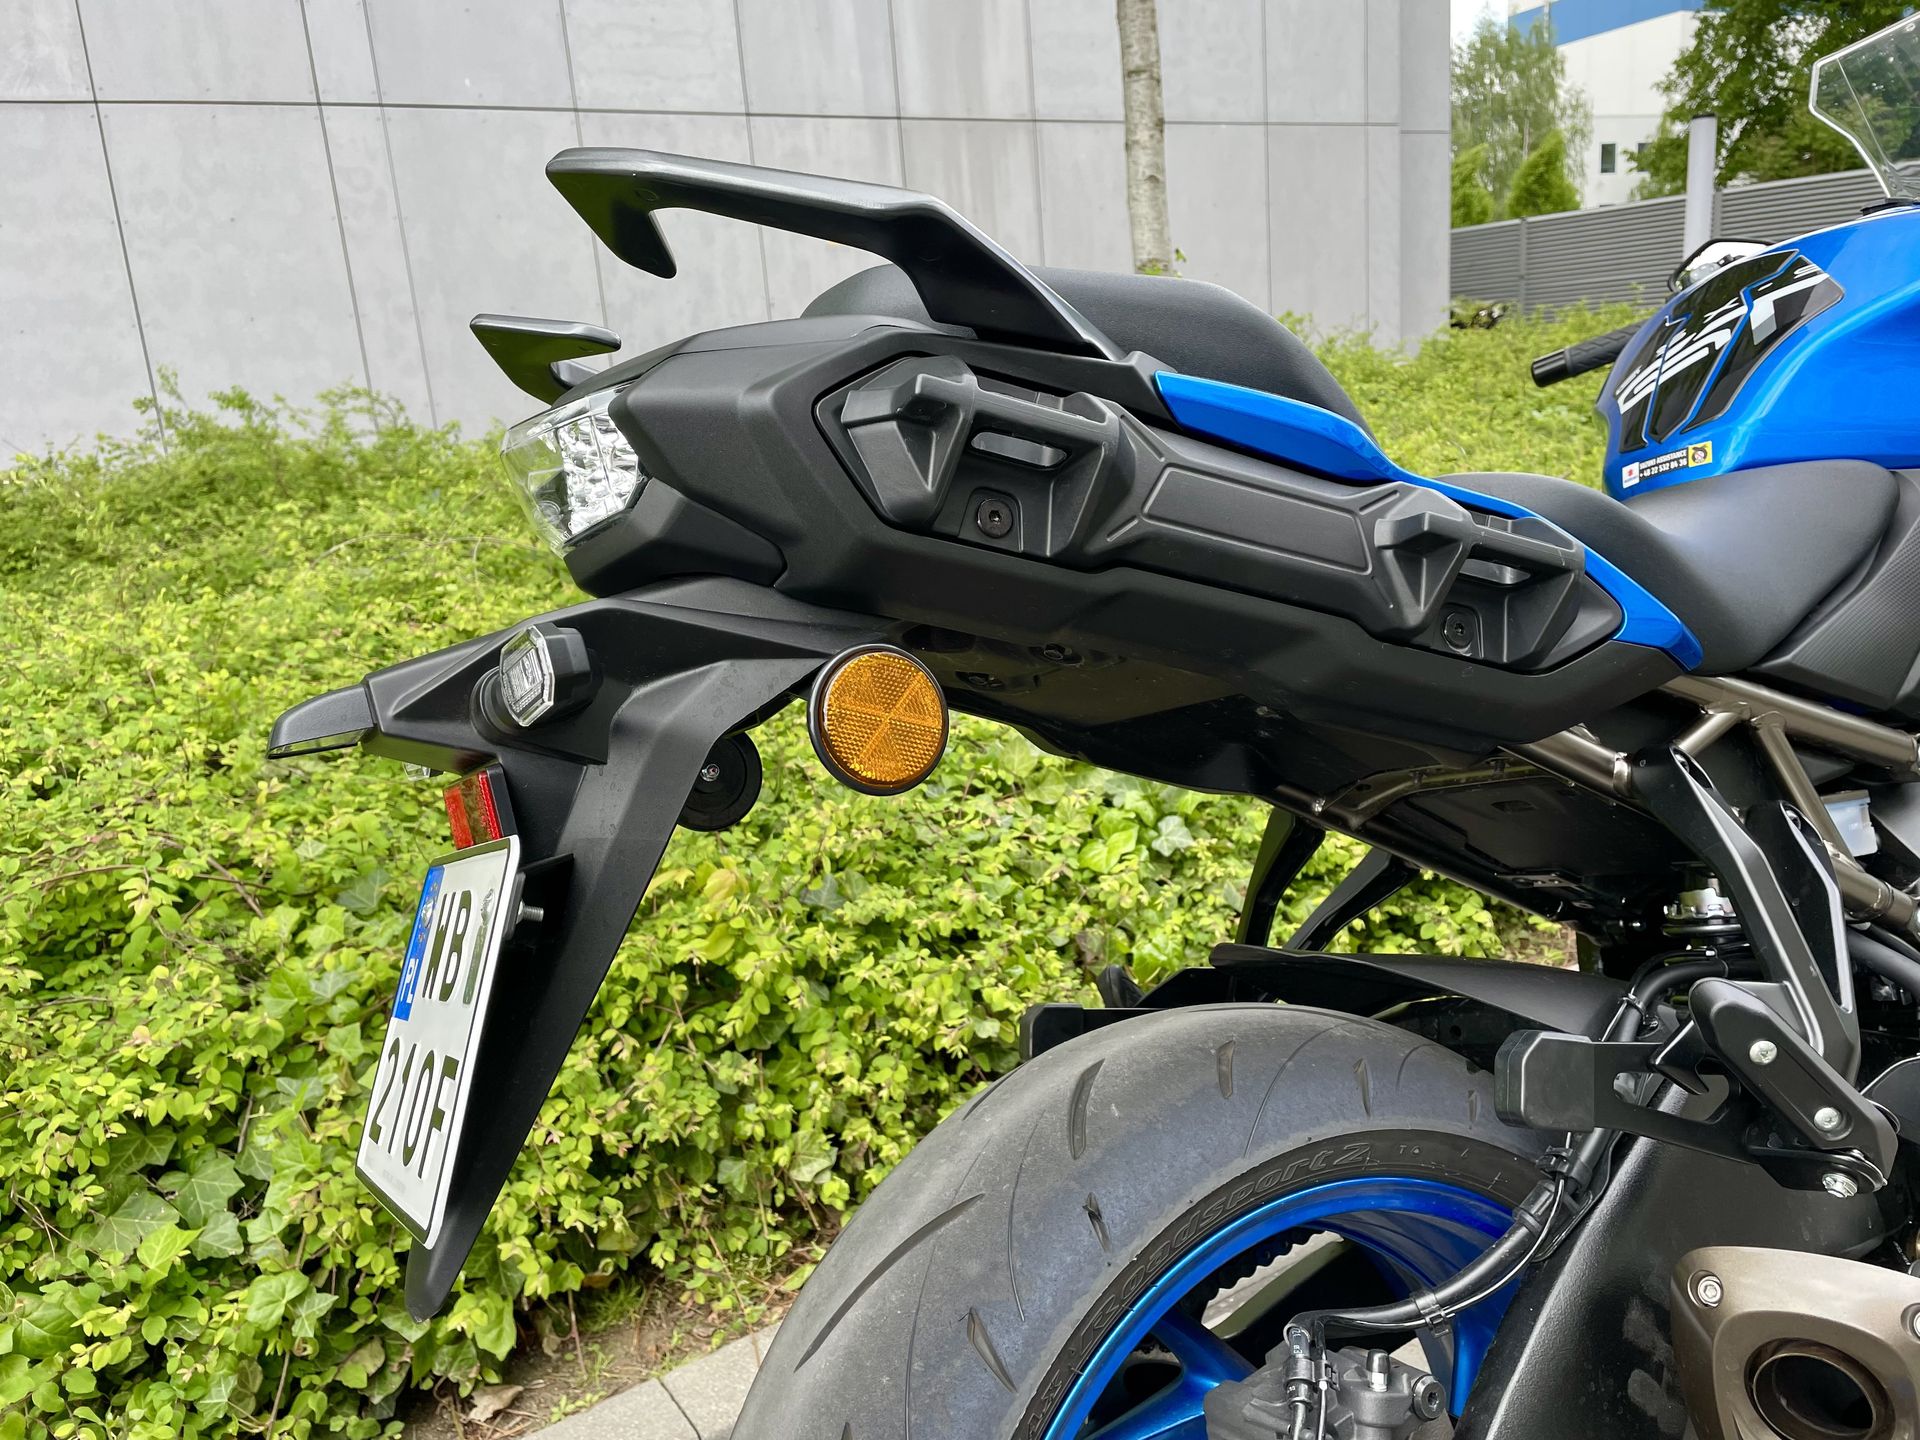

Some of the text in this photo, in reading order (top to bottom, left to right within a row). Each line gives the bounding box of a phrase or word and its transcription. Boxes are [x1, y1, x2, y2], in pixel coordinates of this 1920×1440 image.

[1651, 466, 1658, 475] 22
[400, 958, 419, 1004] PL
[422, 890, 471, 1002] WB
[369, 1037, 459, 1179] 210F
